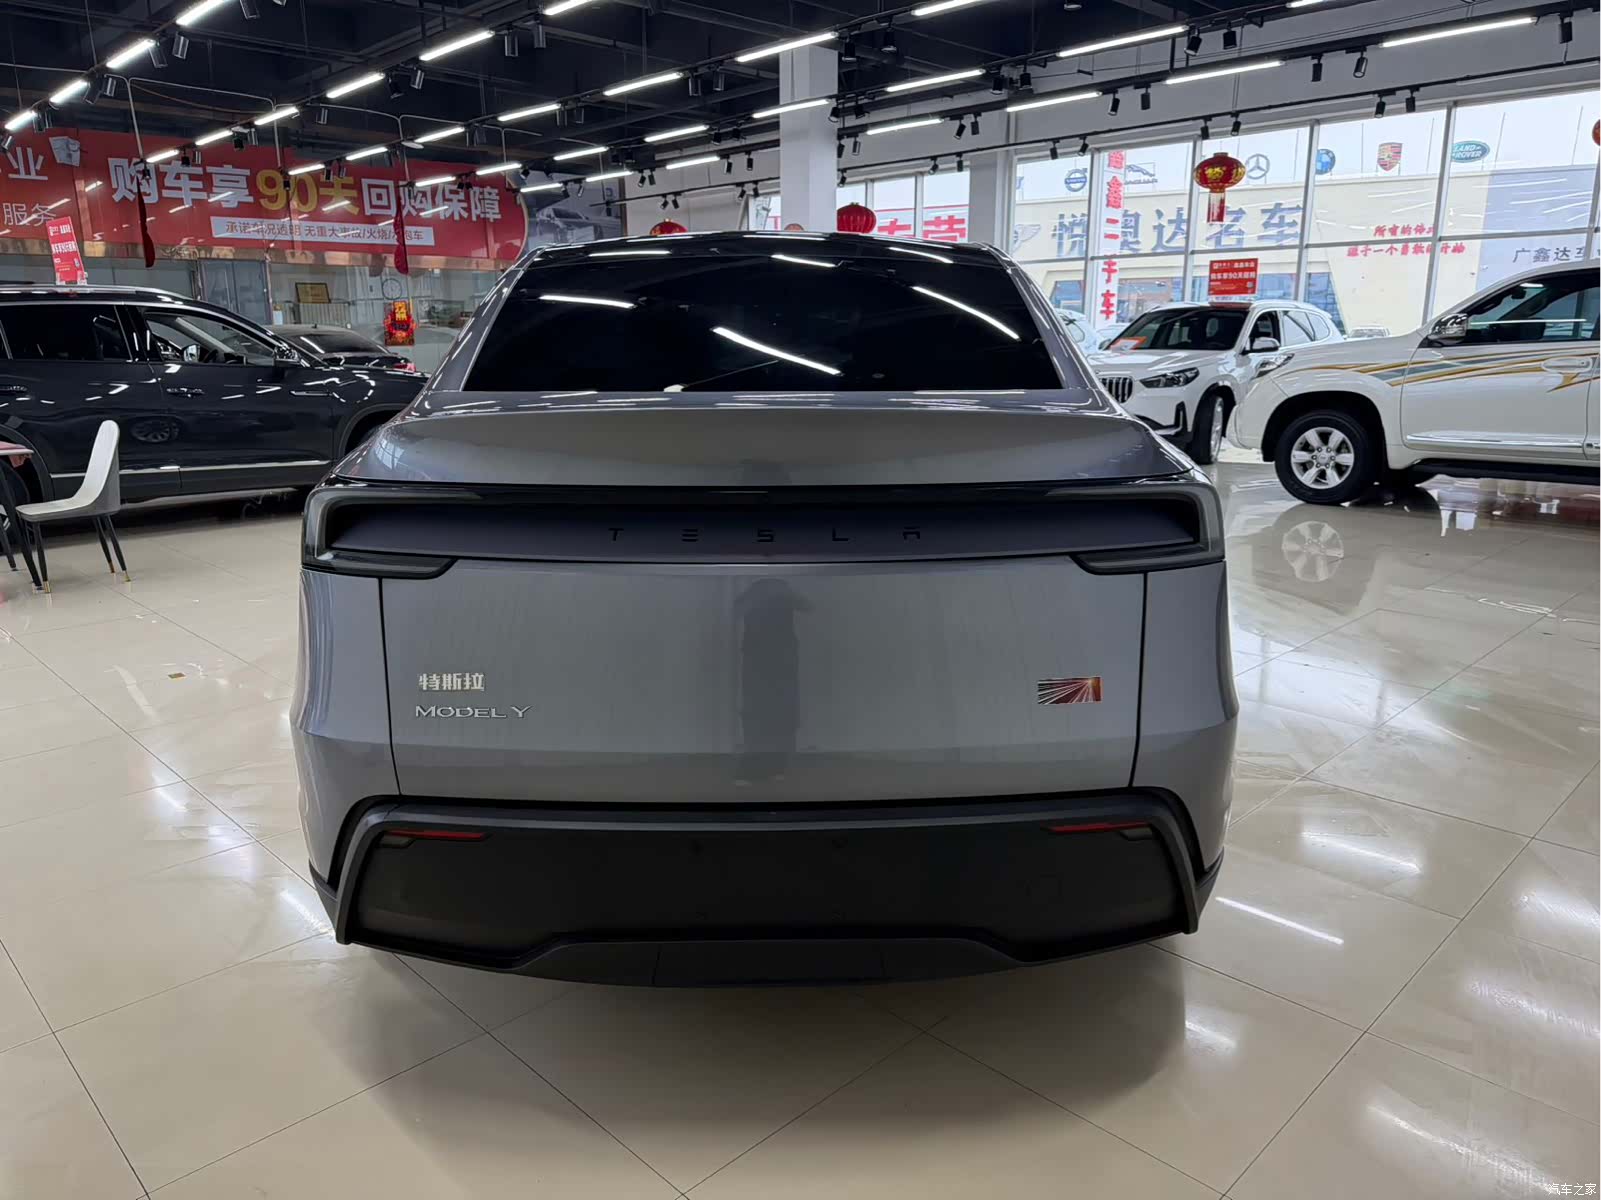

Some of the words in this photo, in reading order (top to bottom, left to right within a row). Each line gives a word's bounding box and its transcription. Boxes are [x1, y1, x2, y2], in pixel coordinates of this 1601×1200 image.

[108, 157, 502, 222] 购车享90天回购保障
[2, 202, 56, 227] 服务
[303, 224, 424, 240] 无重大事故/火烧/泡车
[1050, 202, 1304, 258] 悦奥达名车
[608, 525, 921, 543] TESLA
[419, 672, 485, 691] 特斯拉
[415, 705, 507, 718] MODEL
[510, 705, 533, 718] Y
